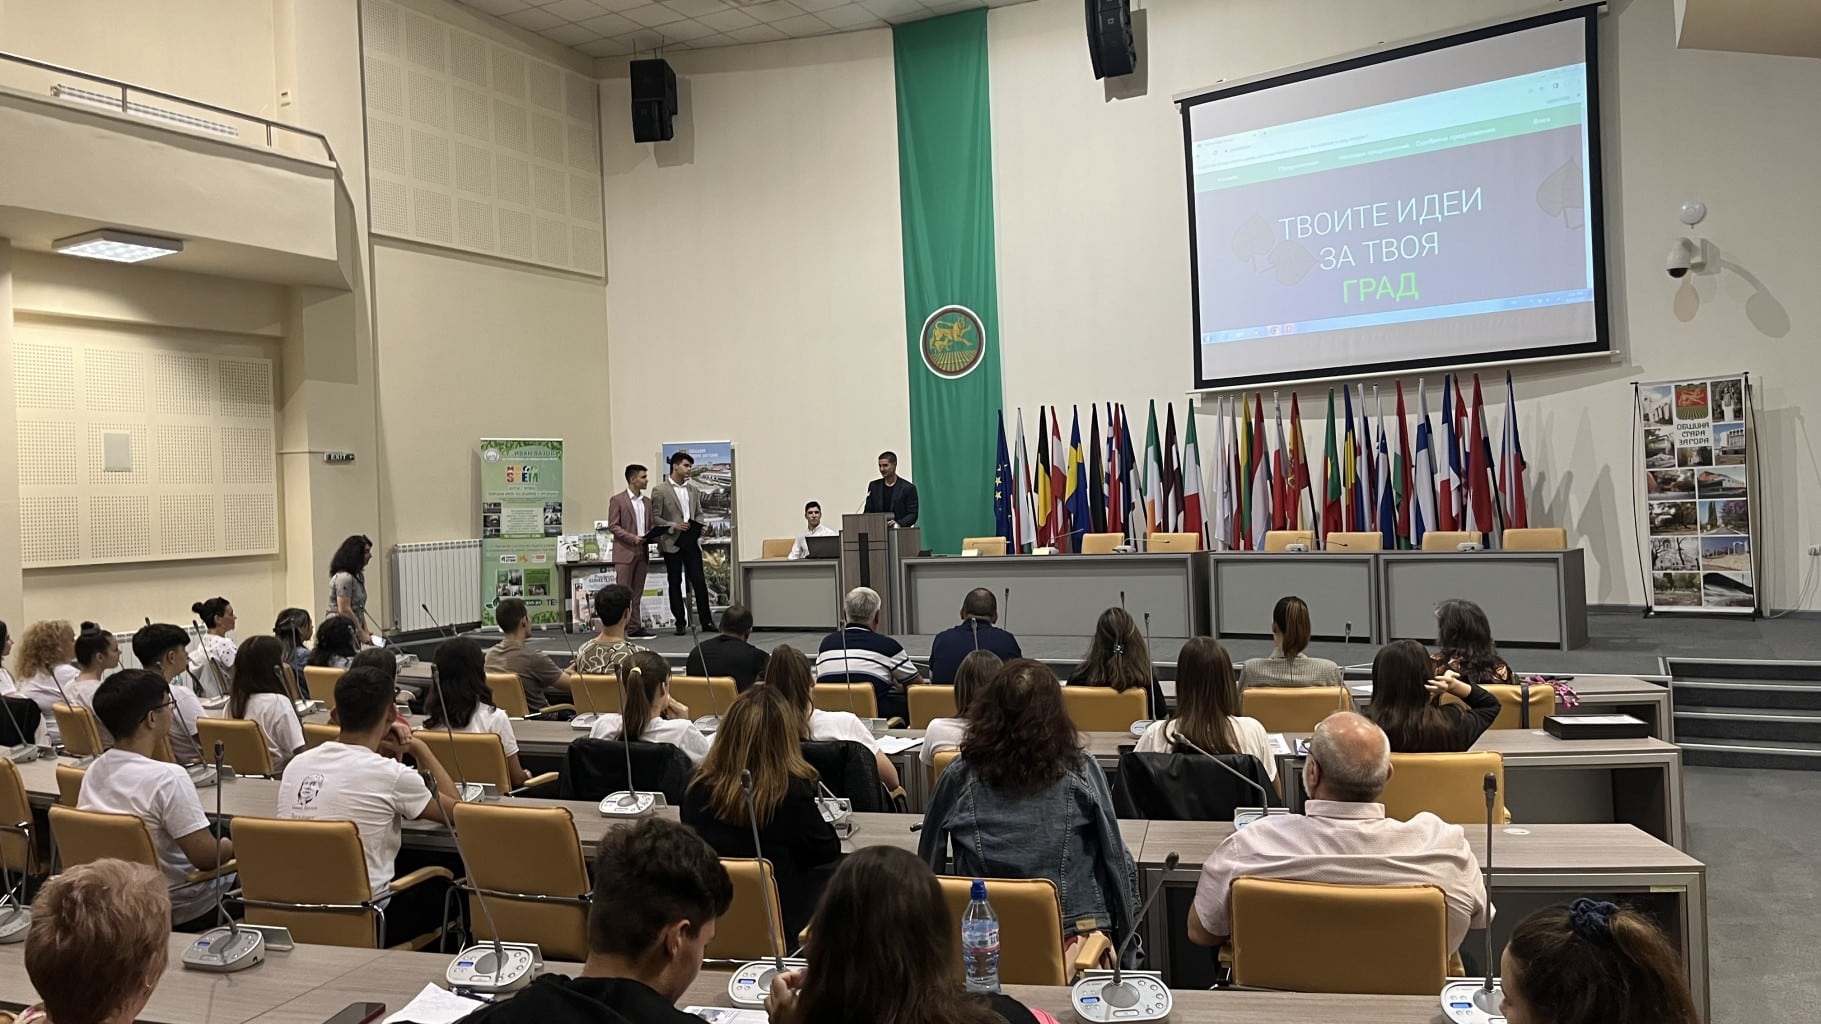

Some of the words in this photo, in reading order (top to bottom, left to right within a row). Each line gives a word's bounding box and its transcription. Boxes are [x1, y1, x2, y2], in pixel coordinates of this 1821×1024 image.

[1278, 202, 1389, 240] ТВОИТЕ
[1397, 186, 1482, 225] ИДЕИ
[1319, 245, 1356, 270] ЗА
[1362, 231, 1439, 264] ТВОЯ
[1343, 271, 1420, 304] ГРАД
[1676, 422, 1710, 430] ОБЩИНА
[1681, 430, 1706, 438] СТАРА
[1679, 437, 1709, 445] ЗАГОРА
